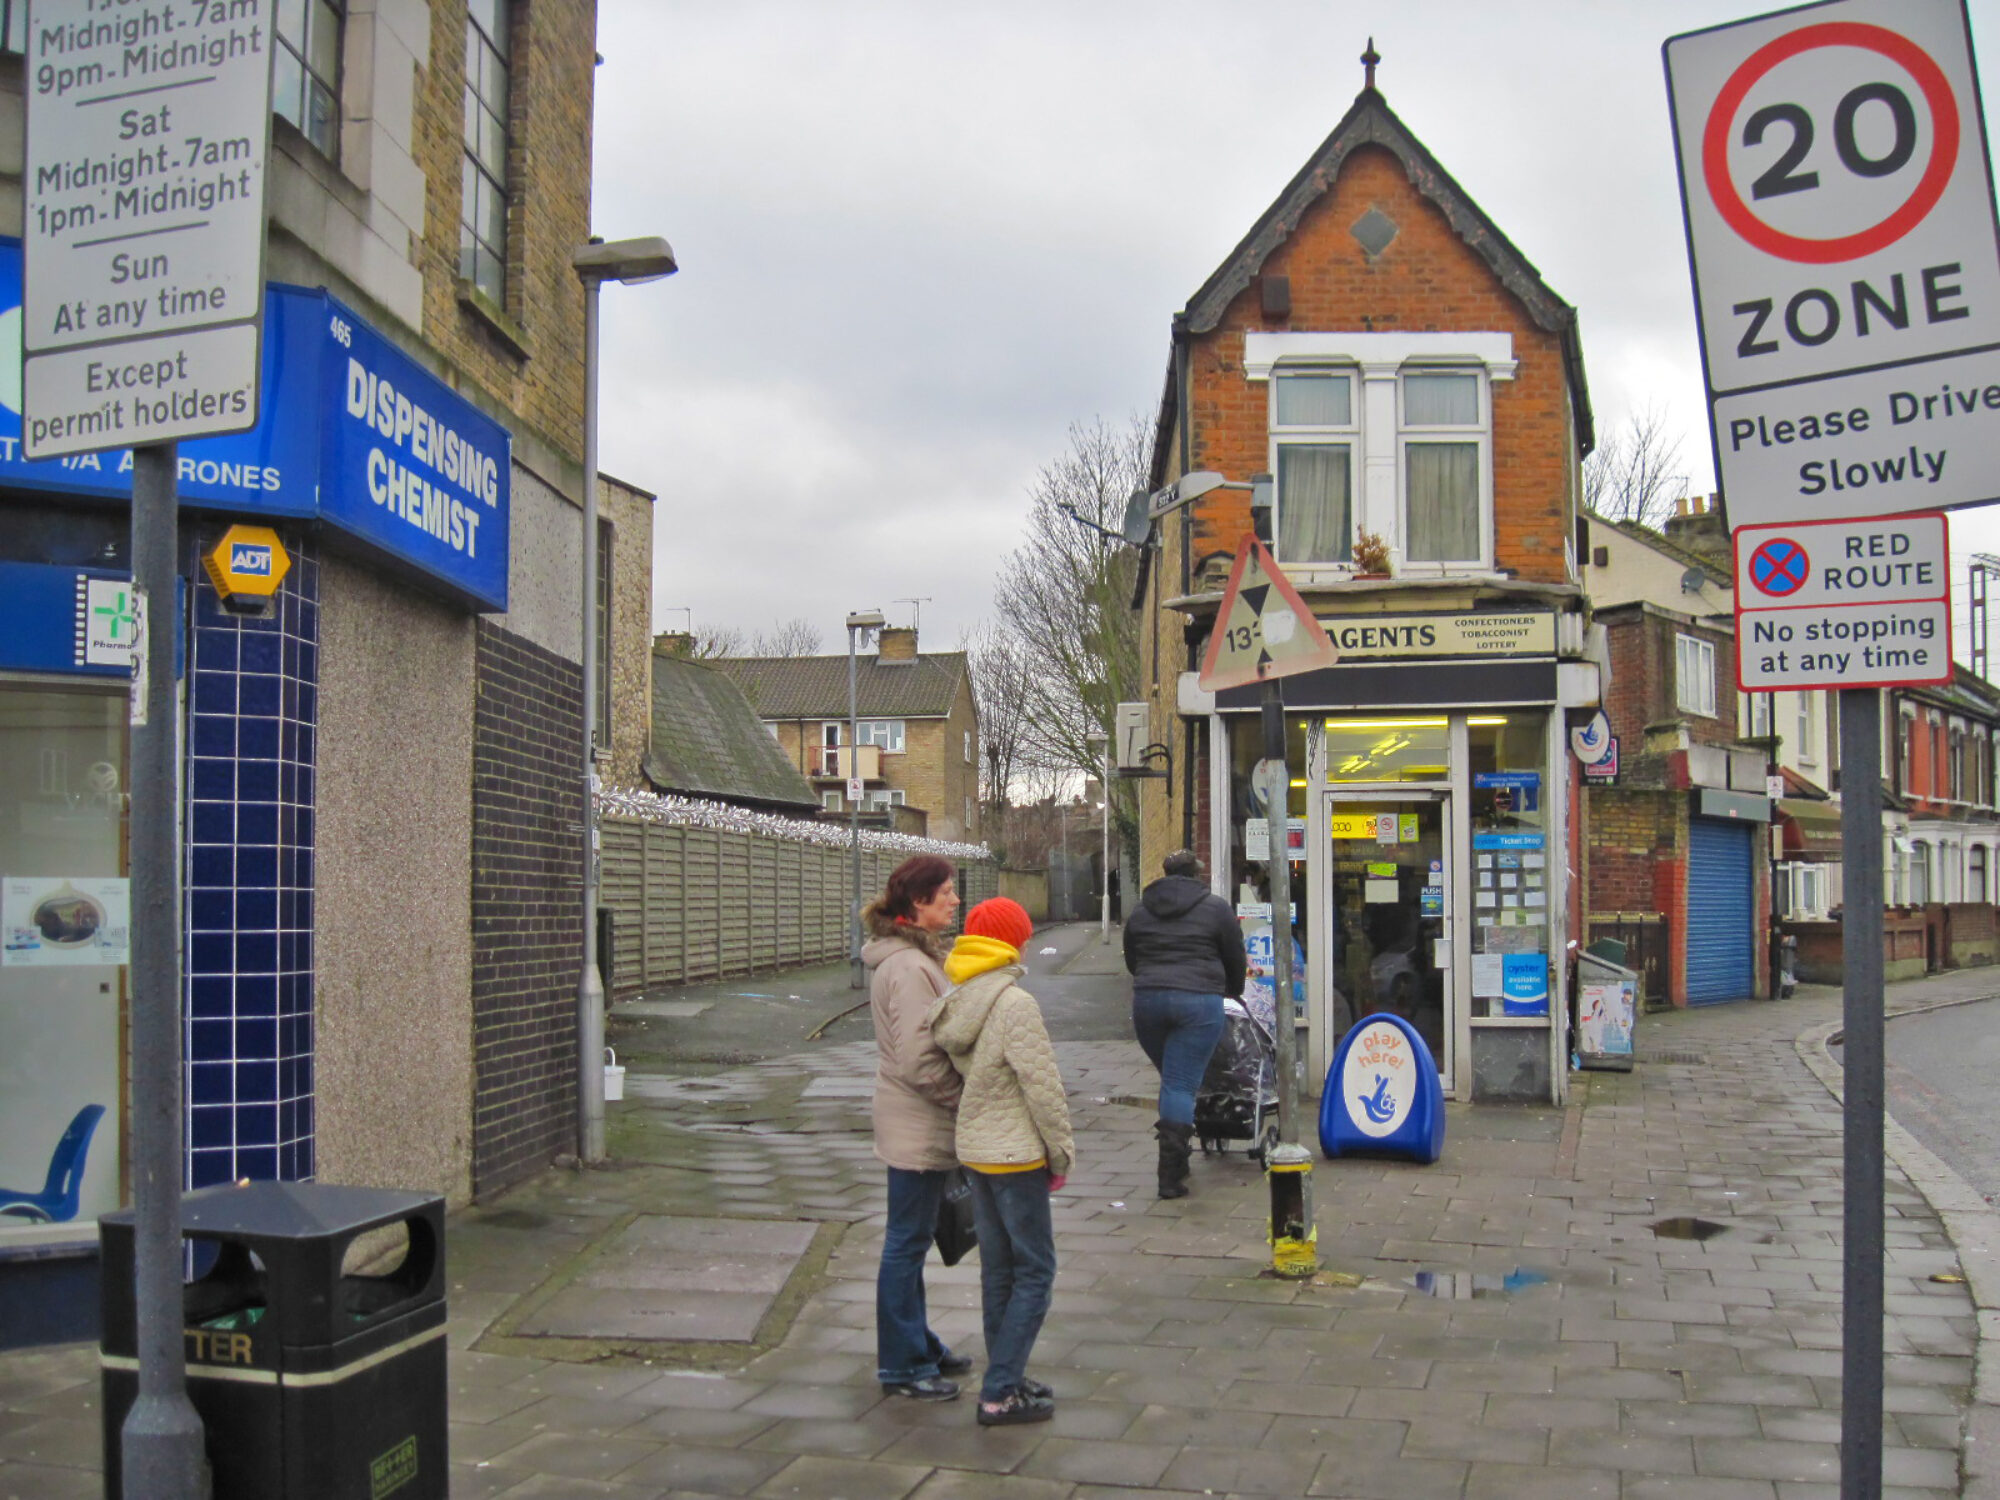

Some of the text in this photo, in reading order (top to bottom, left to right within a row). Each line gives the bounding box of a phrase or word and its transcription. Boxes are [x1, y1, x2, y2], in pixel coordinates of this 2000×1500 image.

[118, 104, 171, 140] Sat
[1743, 82, 1917, 201] 20
[110, 253, 168, 284] Sun
[53, 286, 226, 334] At any time
[1733, 262, 1970, 359] ZONE
[330, 316, 352, 348] 465
[87, 350, 188, 393] Except
[32, 389, 247, 447] permit holders
[347, 356, 498, 509] DISPENSING
[1730, 384, 2000, 452] Please Drive
[1799, 446, 1947, 495] Slowly
[367, 447, 480, 559] CHEMIST
[232, 550, 270, 570] ADT
[1845, 533, 1910, 559] RED
[1824, 561, 1934, 590] ROUTE
[1454, 616, 1536, 627] CONFECTIONERS
[1461, 628, 1529, 638] TOBACCONIST
[1754, 613, 1935, 643] No stopping
[1477, 640, 1517, 649] LOTTERY
[1760, 645, 1928, 675] at any time
[1421, 887, 1442, 895] PUSH
[1507, 964, 1540, 975] oyster
[1363, 1031, 1402, 1051] play
[183, 1329, 253, 1364] TER
